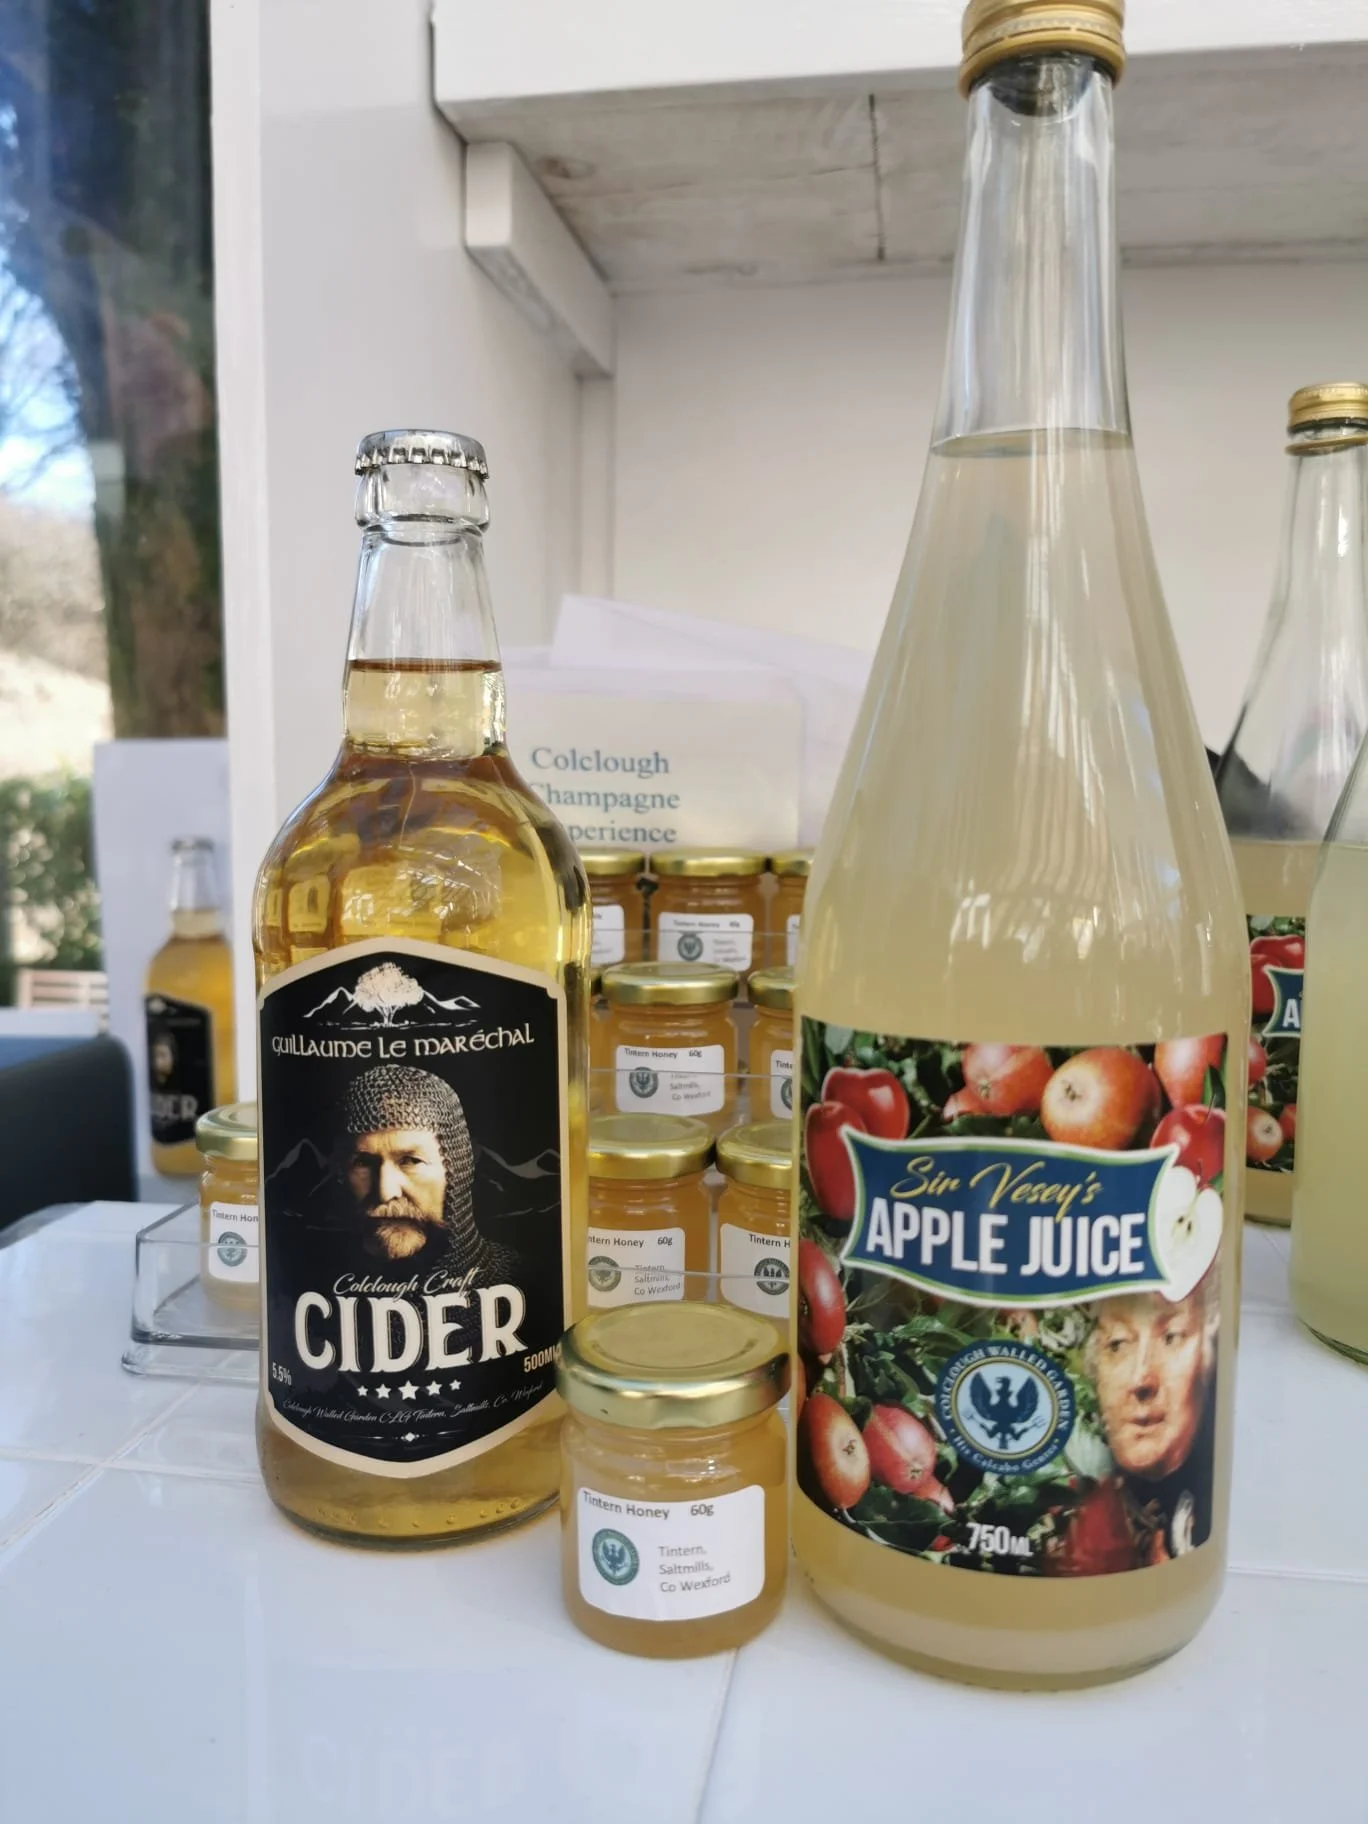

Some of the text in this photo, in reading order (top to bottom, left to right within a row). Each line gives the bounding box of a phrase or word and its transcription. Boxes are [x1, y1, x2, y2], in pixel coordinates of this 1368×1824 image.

[531, 746, 671, 780] Colclough
[568, 819, 678, 844] perience
[651, 1050, 678, 1059] Honey
[890, 1156, 1102, 1223] Sir Vesey's
[240, 1213, 259, 1223] Hon
[588, 1235, 673, 1249] ntern Honey 60g
[749, 1233, 781, 1248] Tintern
[865, 1197, 1146, 1278] APPLE JUICE
[333, 1266, 481, 1303] Colclough Craft
[294, 1283, 528, 1374] CIDER
[940, 1345, 1071, 1430] COLCLOUGH WALLED GARDEN
[583, 1490, 714, 1521] Tintern Honey 60g
[966, 1522, 1033, 1557] 750ML
[660, 1572, 731, 1593] Co Wexford
